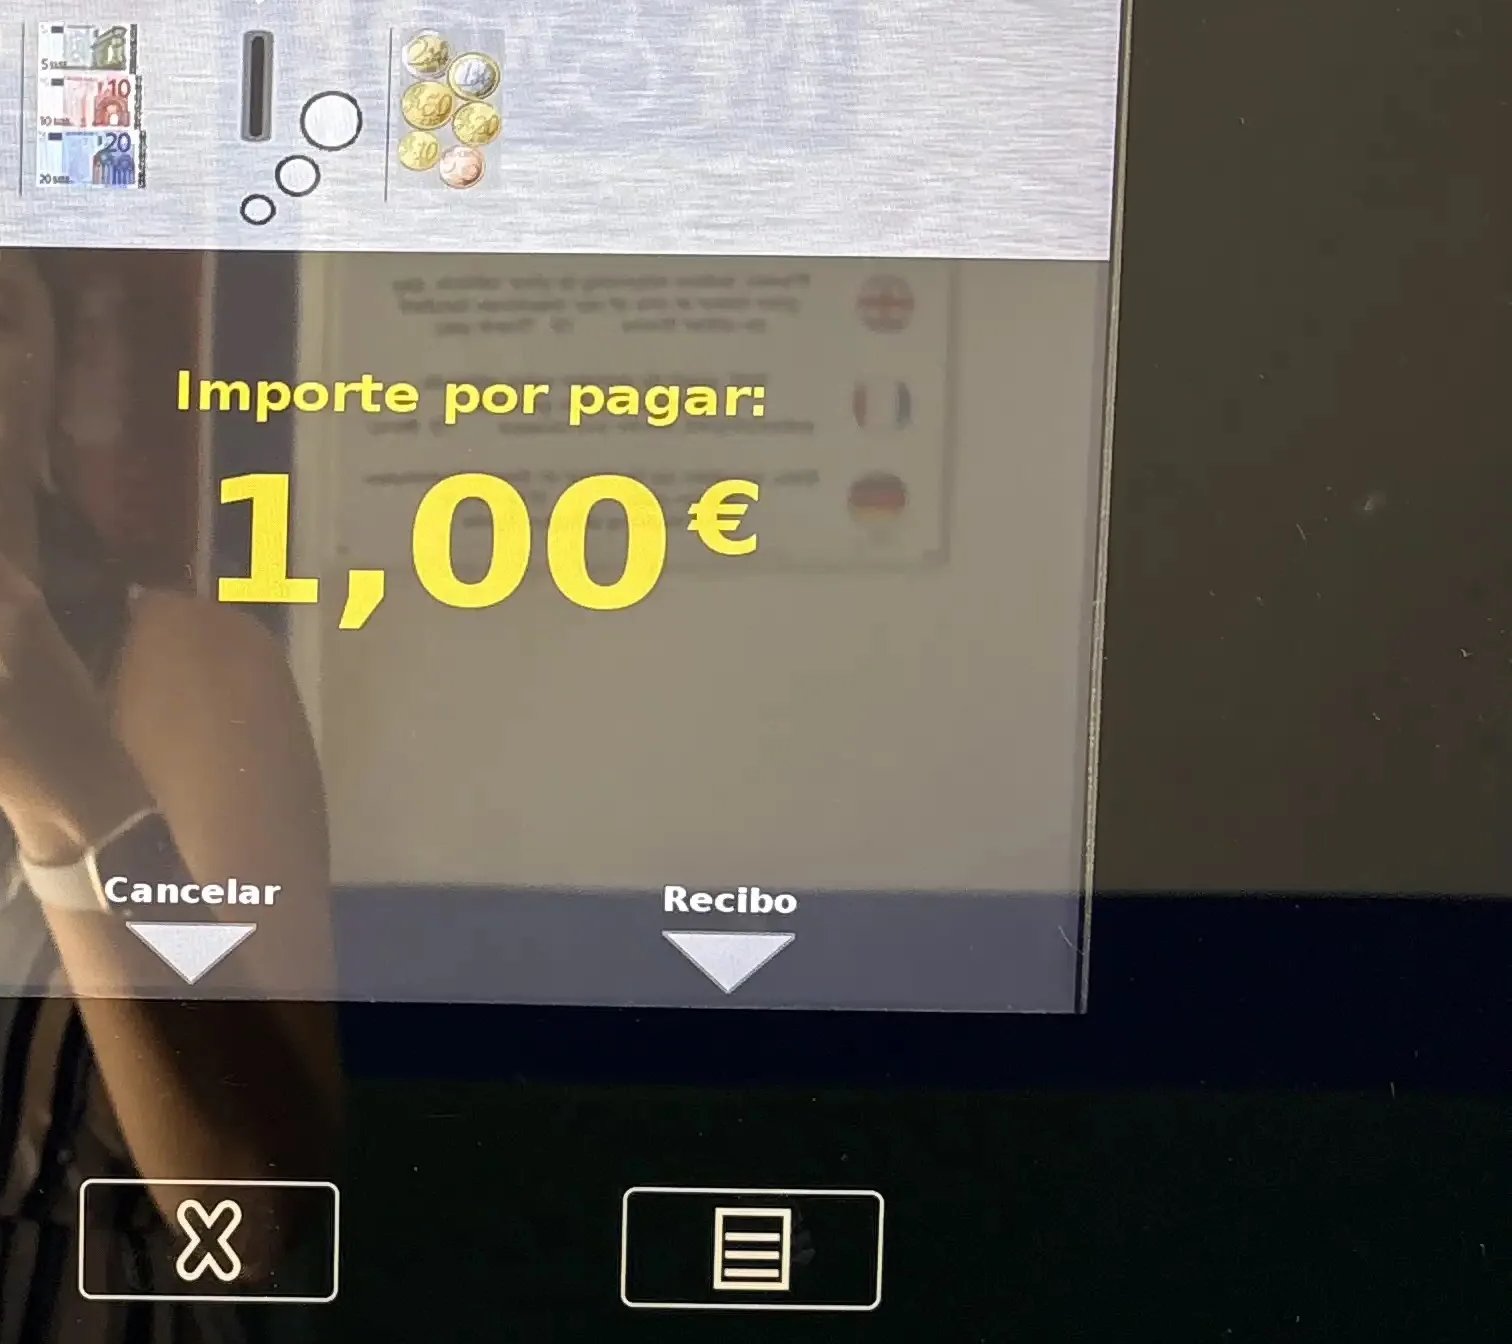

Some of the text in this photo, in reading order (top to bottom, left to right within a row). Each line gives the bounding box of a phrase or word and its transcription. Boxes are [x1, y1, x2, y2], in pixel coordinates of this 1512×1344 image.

[107, 78, 131, 98] 10
[105, 132, 131, 153] 20
[176, 370, 767, 427] Importe por pagar:
[103, 876, 282, 907] Cancelar
[663, 884, 798, 914] Recibo
